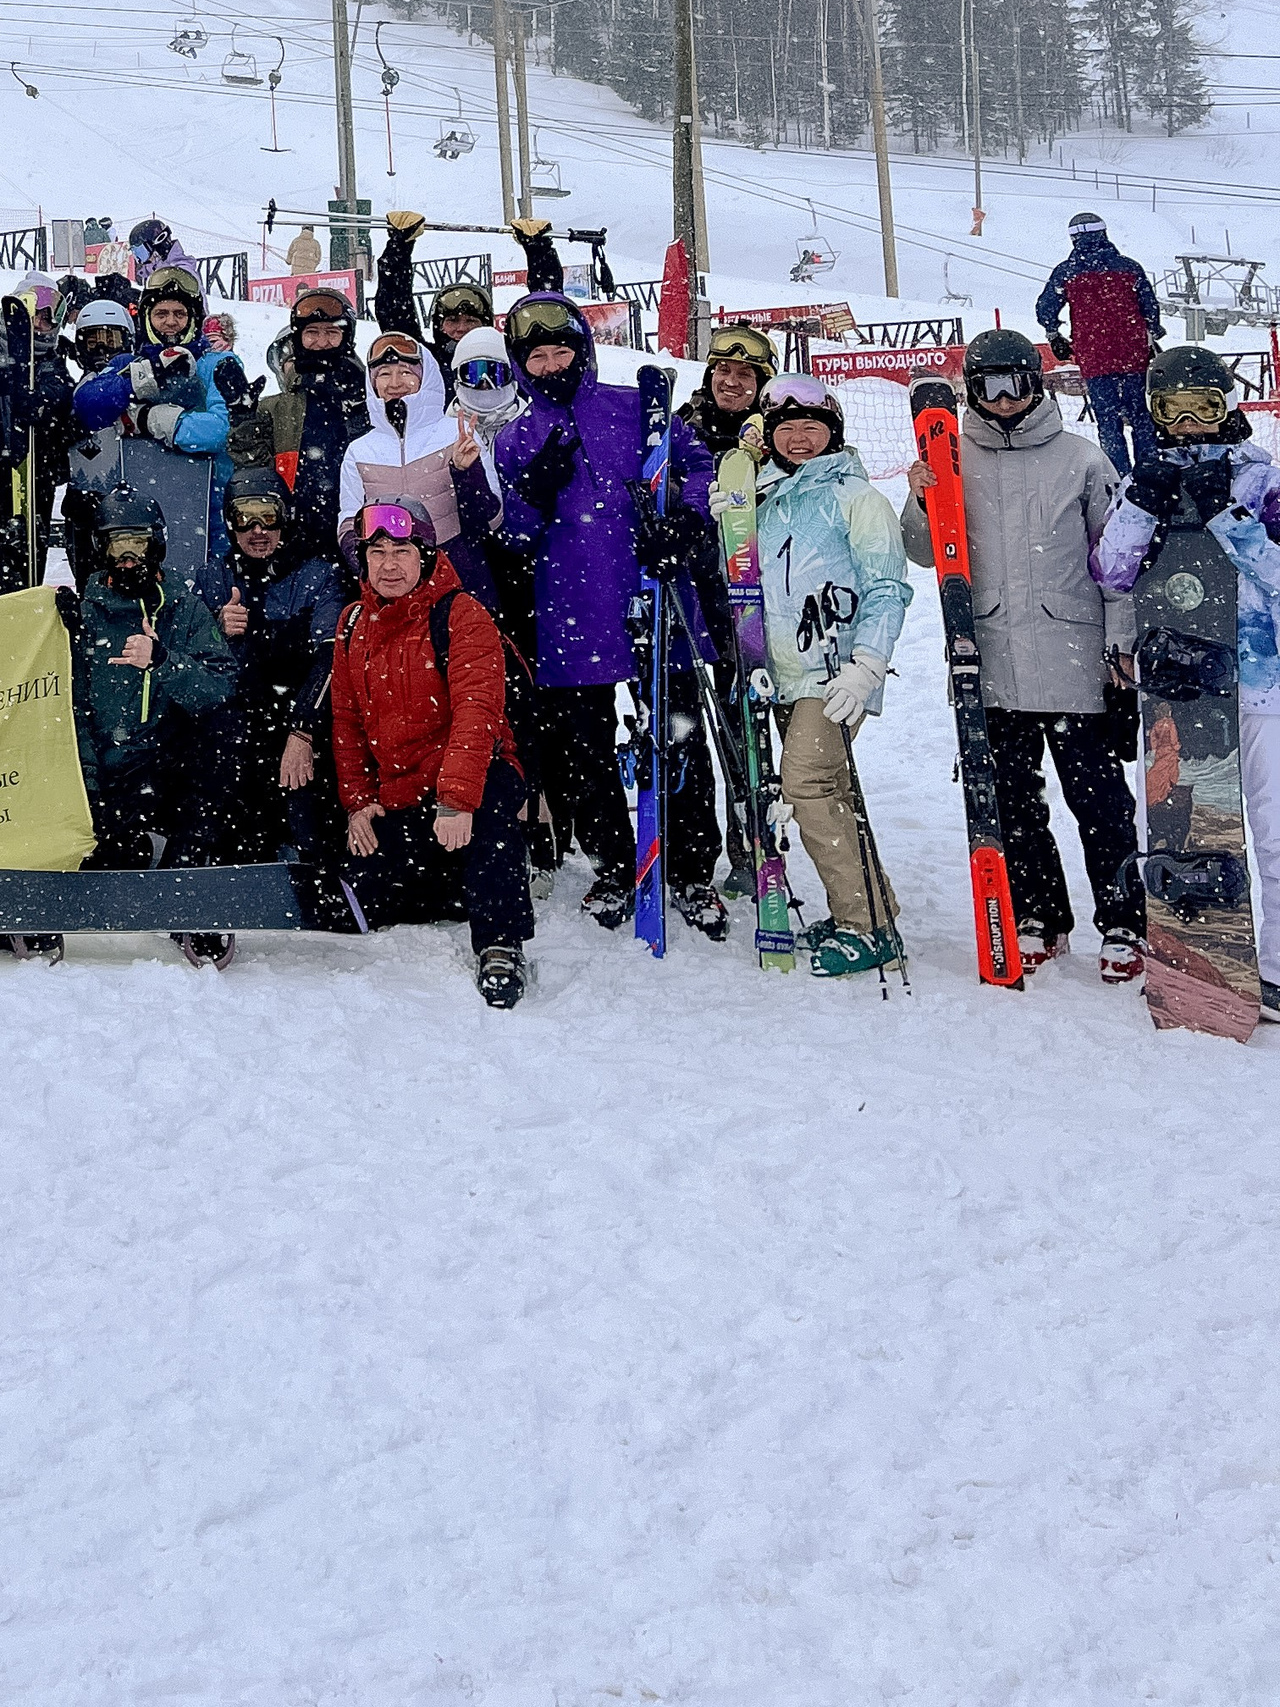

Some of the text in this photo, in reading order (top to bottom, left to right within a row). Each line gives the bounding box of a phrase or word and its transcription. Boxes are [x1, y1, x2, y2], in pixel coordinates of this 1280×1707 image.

[494, 274, 516, 285] БАНИ
[252, 283, 285, 304] PIZZA
[816, 352, 947, 372] ТУРЫ ВЫХОДНОГО
[987, 898, 1005, 964] DISRUPTION
